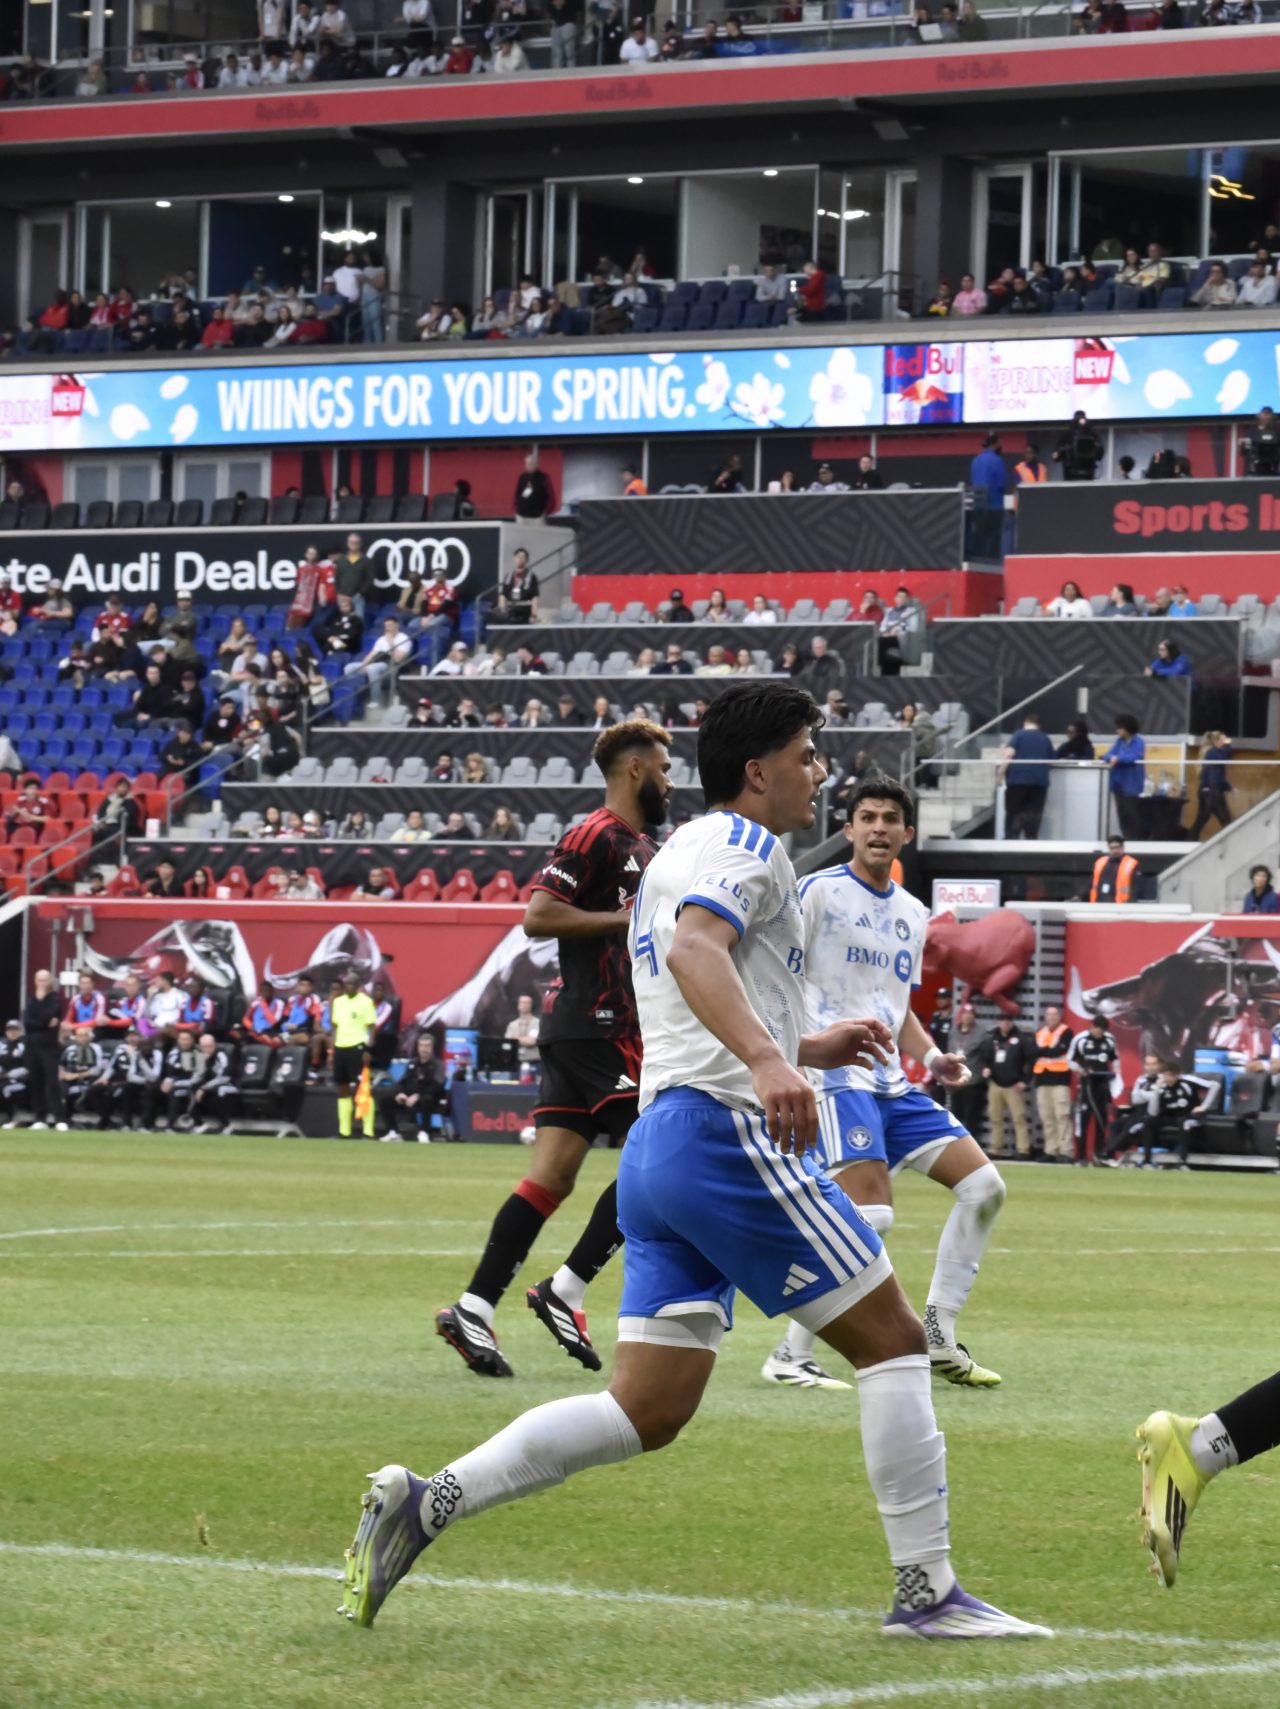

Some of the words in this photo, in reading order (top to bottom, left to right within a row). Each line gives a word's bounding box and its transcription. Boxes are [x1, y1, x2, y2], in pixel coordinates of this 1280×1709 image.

[1075, 356, 1110, 380] NEW
[54, 391, 83, 412] NEW
[217, 375, 354, 432] WIIINGS
[362, 373, 432, 428] FOR
[442, 370, 542, 426] YOUR
[551, 365, 697, 423] SPRING.
[1113, 499, 1249, 537] Sports
[62, 552, 160, 593] Audi
[175, 550, 297, 591] Deale
[550, 866, 578, 889] OANDA
[938, 886, 965, 903] Red
[846, 946, 889, 969] BMO
[472, 1110, 506, 1131] Red
